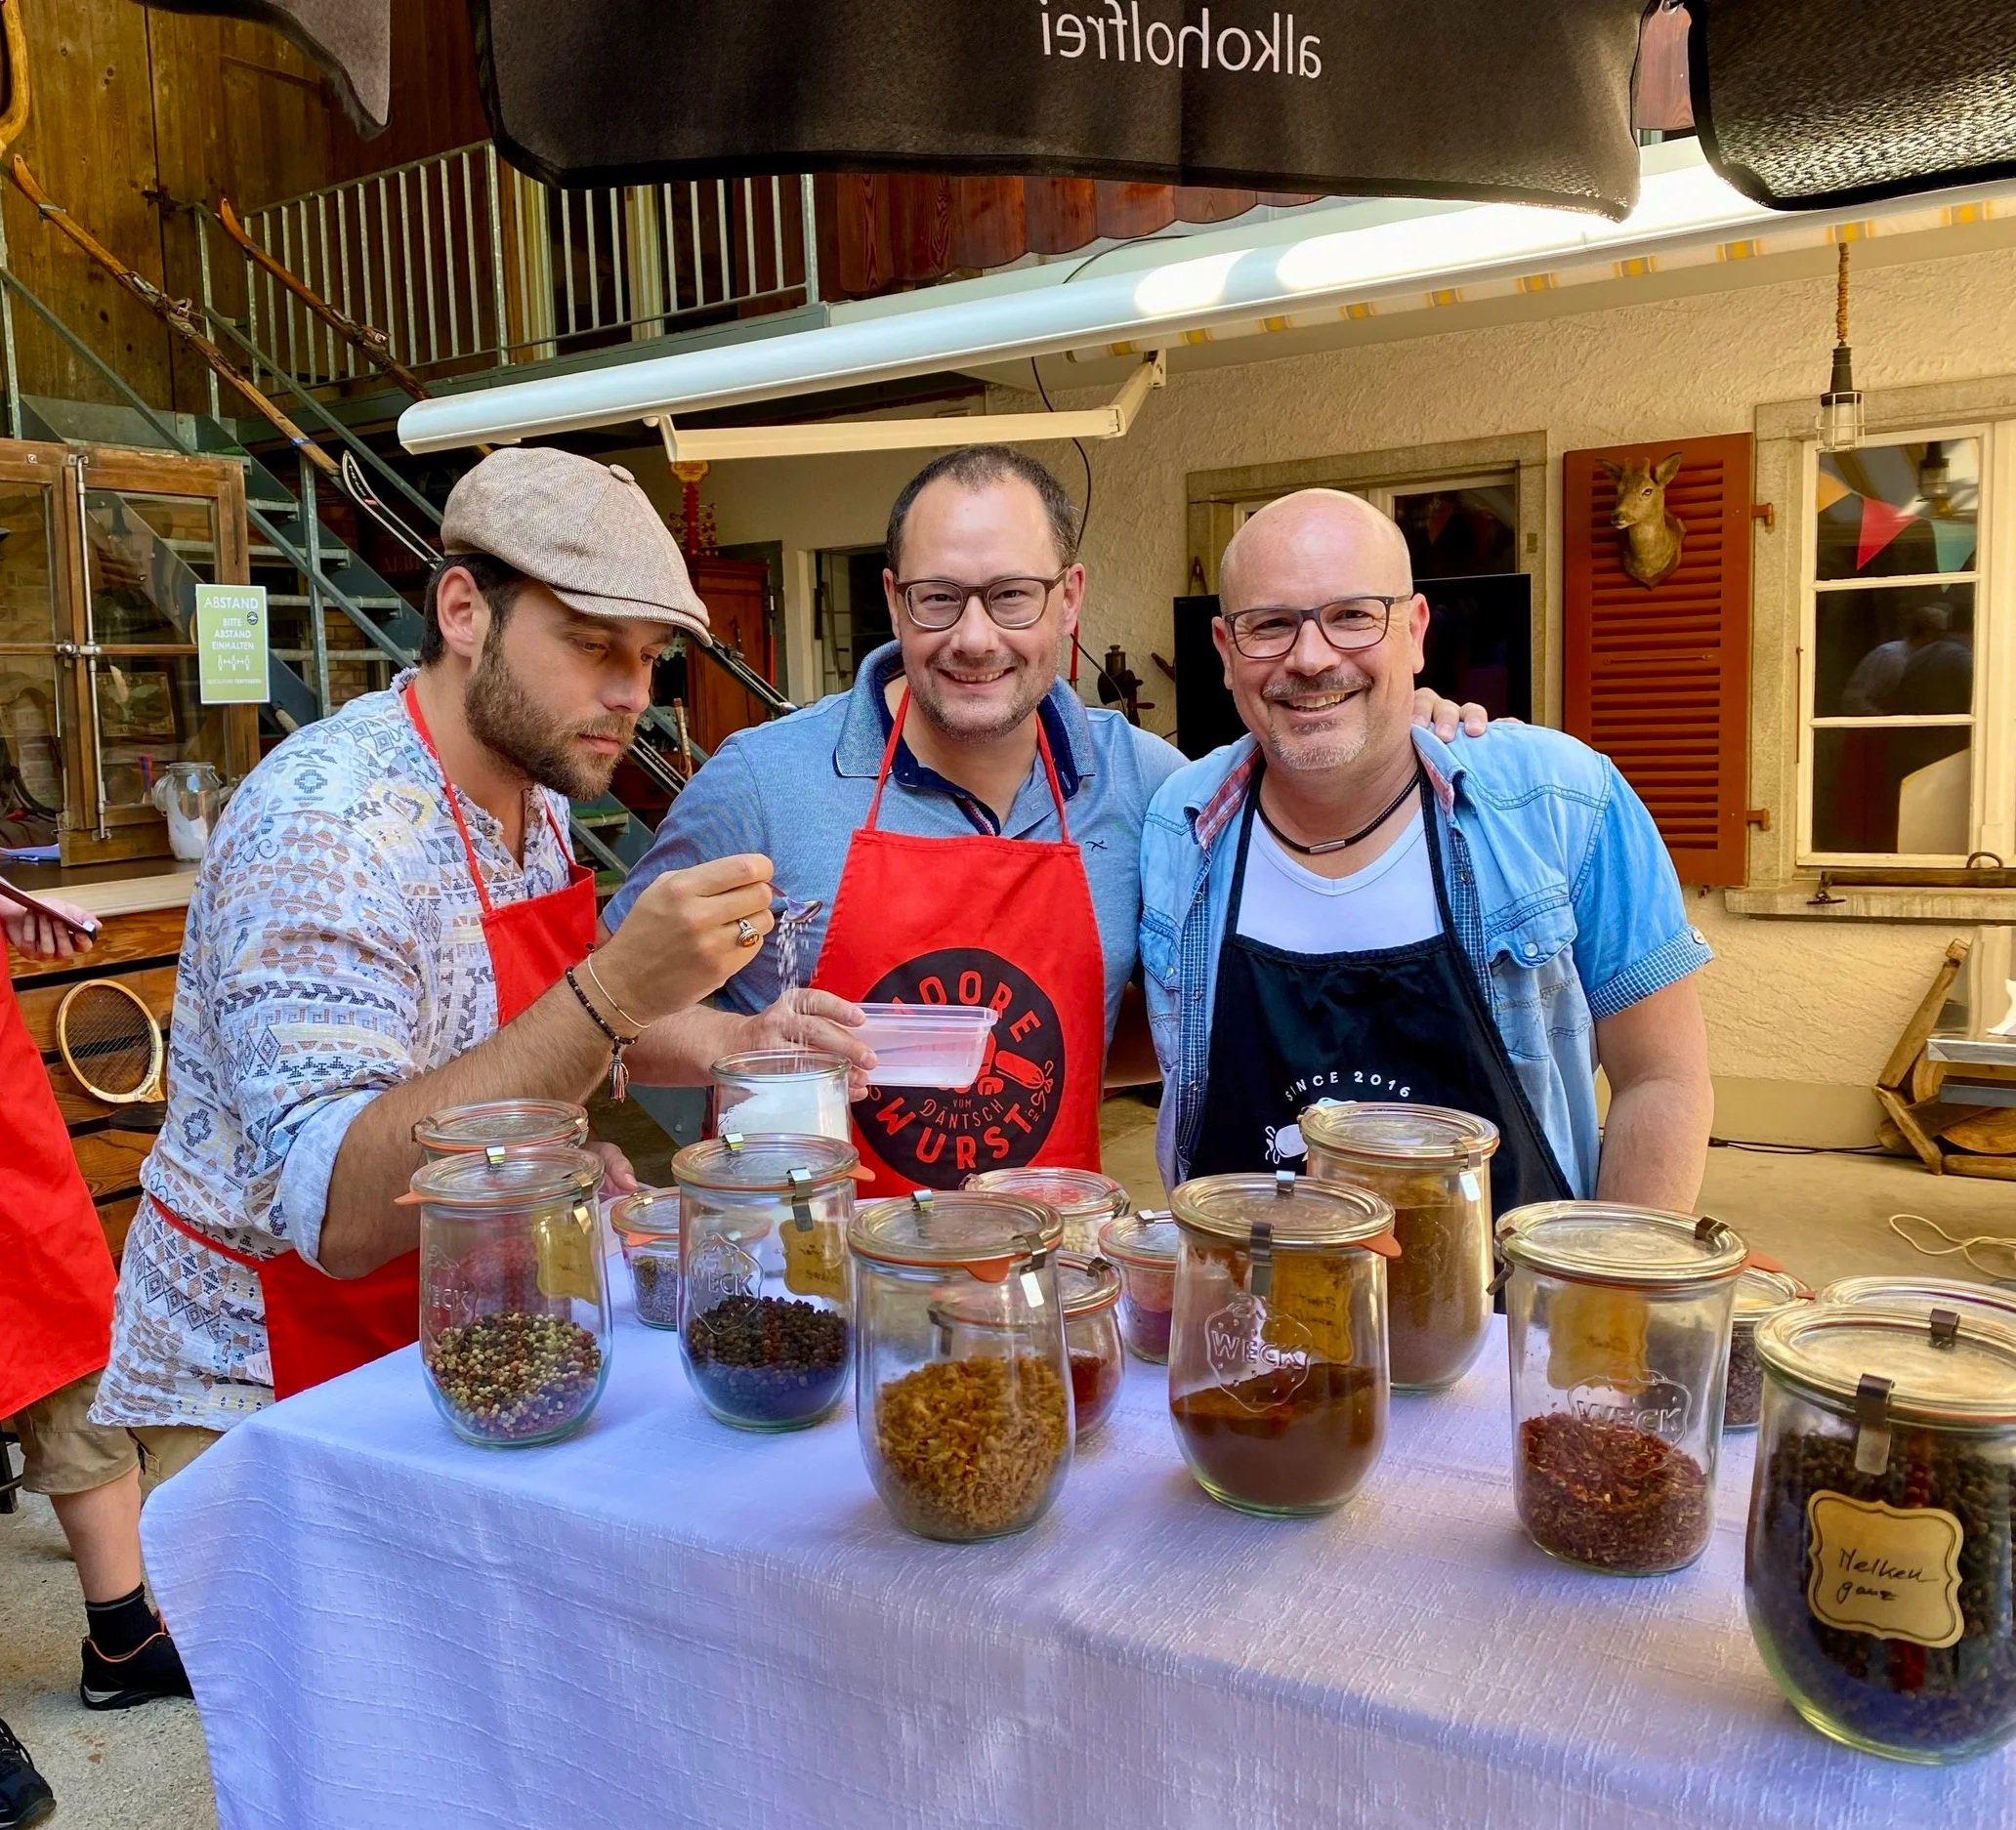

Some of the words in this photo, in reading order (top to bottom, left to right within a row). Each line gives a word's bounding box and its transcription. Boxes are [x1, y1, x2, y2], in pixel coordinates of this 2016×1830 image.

[204, 597, 259, 609] ABSTAND
[223, 617, 242, 627] BITTE
[215, 630, 251, 639] ABSTAND
[212, 642, 254, 650] EINHALTEN
[882, 970, 1041, 1043] OORE
[1284, 1071, 1339, 1102] SINCE
[1354, 1070, 1411, 1098] 2016
[952, 1099, 972, 1108] VOM
[875, 1097, 1032, 1170] WURST
